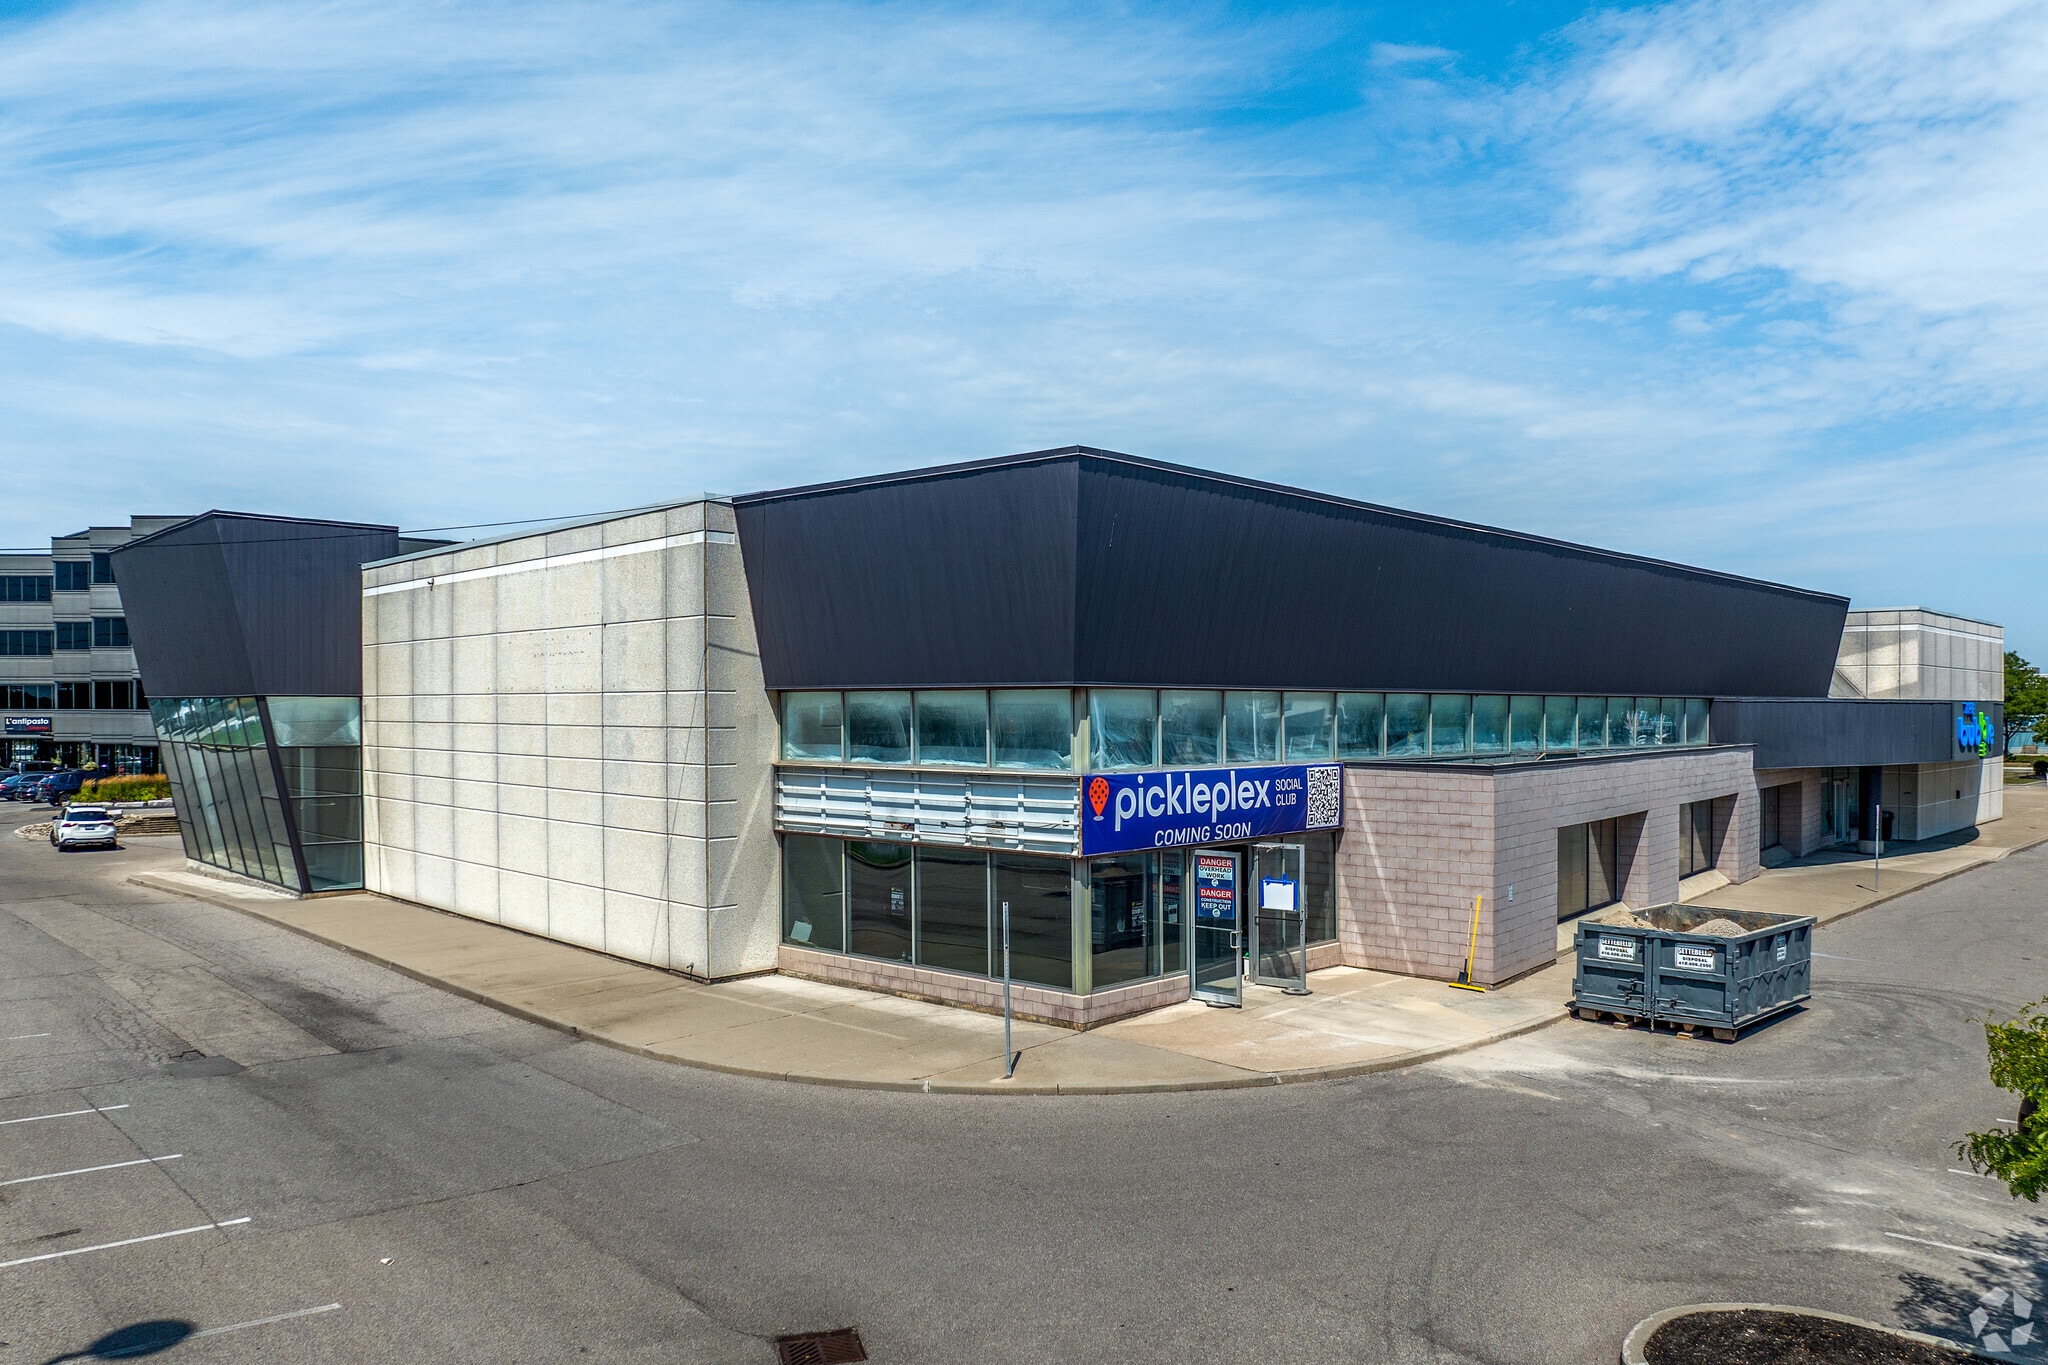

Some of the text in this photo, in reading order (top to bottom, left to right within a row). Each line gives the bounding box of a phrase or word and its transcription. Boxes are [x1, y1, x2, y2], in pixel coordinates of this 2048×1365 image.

[5, 718, 49, 726] L'antipasto
[1957, 711, 1994, 746] bubble
[1275, 778, 1303, 791] SOCIAL
[1114, 770, 1271, 832] pickleplex
[1275, 793, 1297, 807] CLUB
[1154, 822, 1251, 846] COMING SOON
[1200, 858, 1232, 867] DANGER
[1200, 889, 1232, 898] DANGER
[1601, 938, 1632, 948] SETTEBELLO
